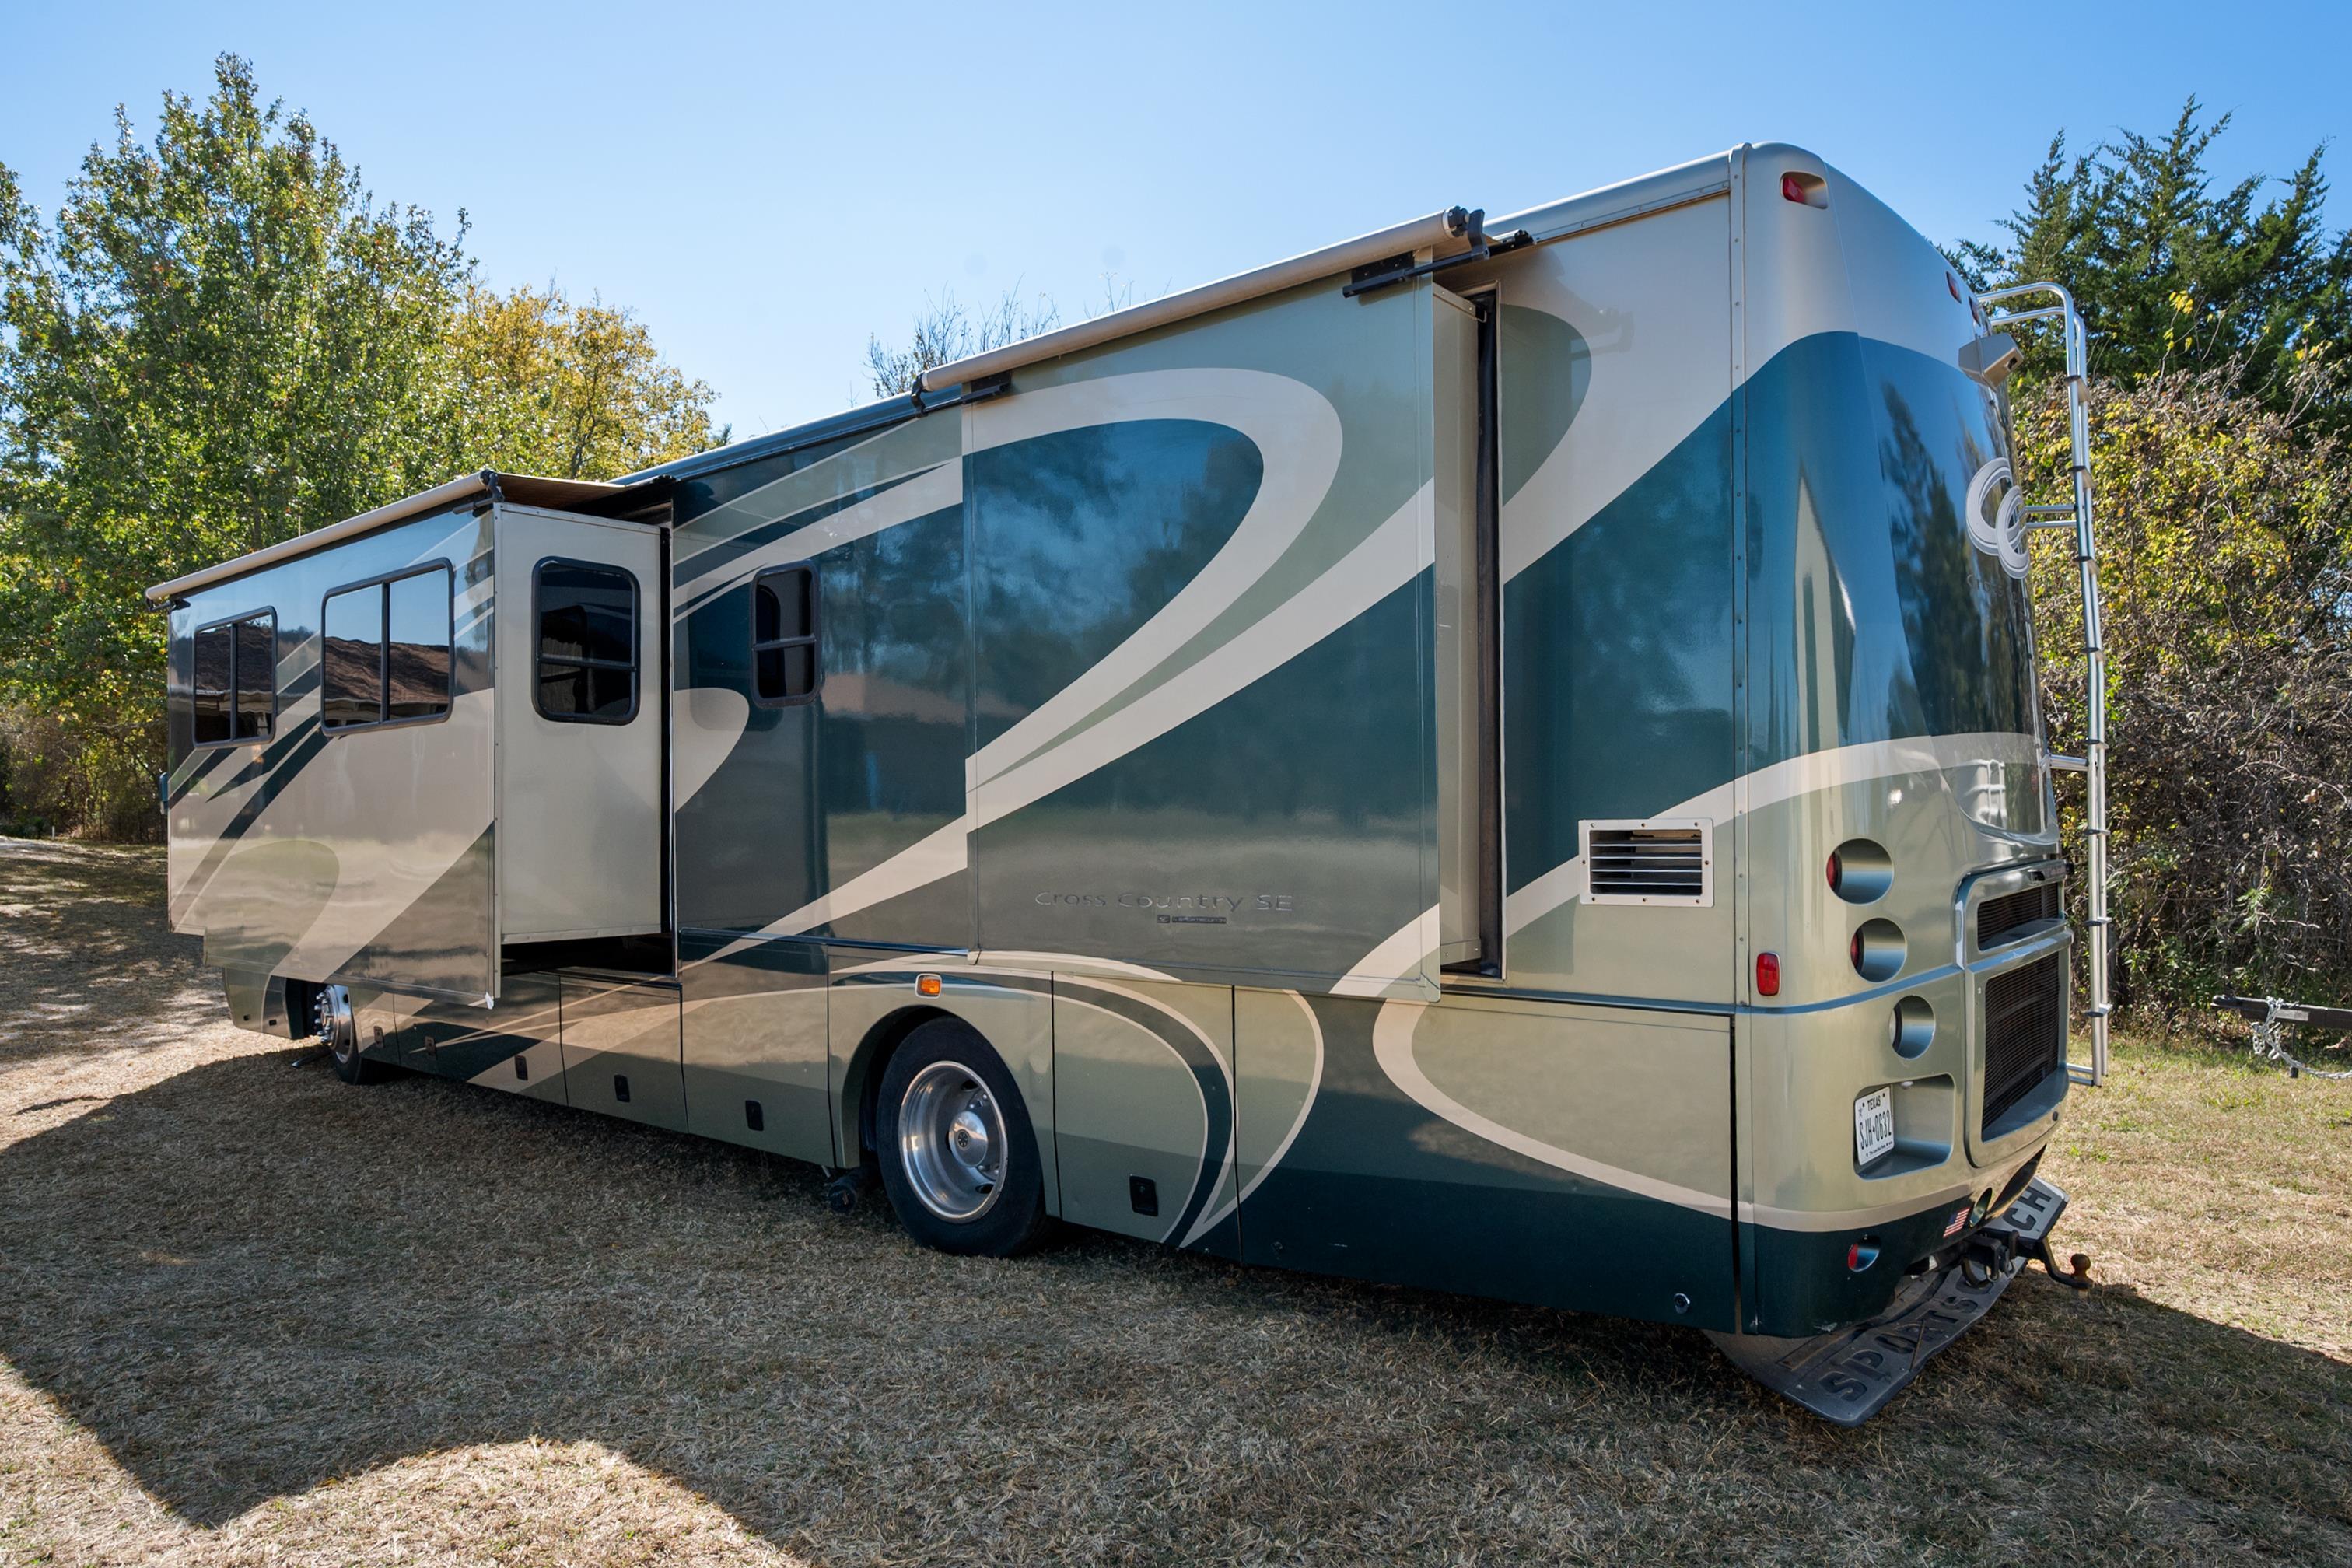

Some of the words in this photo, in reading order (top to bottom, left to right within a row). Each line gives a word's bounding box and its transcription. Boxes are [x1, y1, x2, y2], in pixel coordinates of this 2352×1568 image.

[1034, 891, 1106, 907] Cross
[1118, 894, 1243, 912] Country
[1256, 894, 1293, 912] SE
[1867, 1095, 1881, 1111] TEXAS
